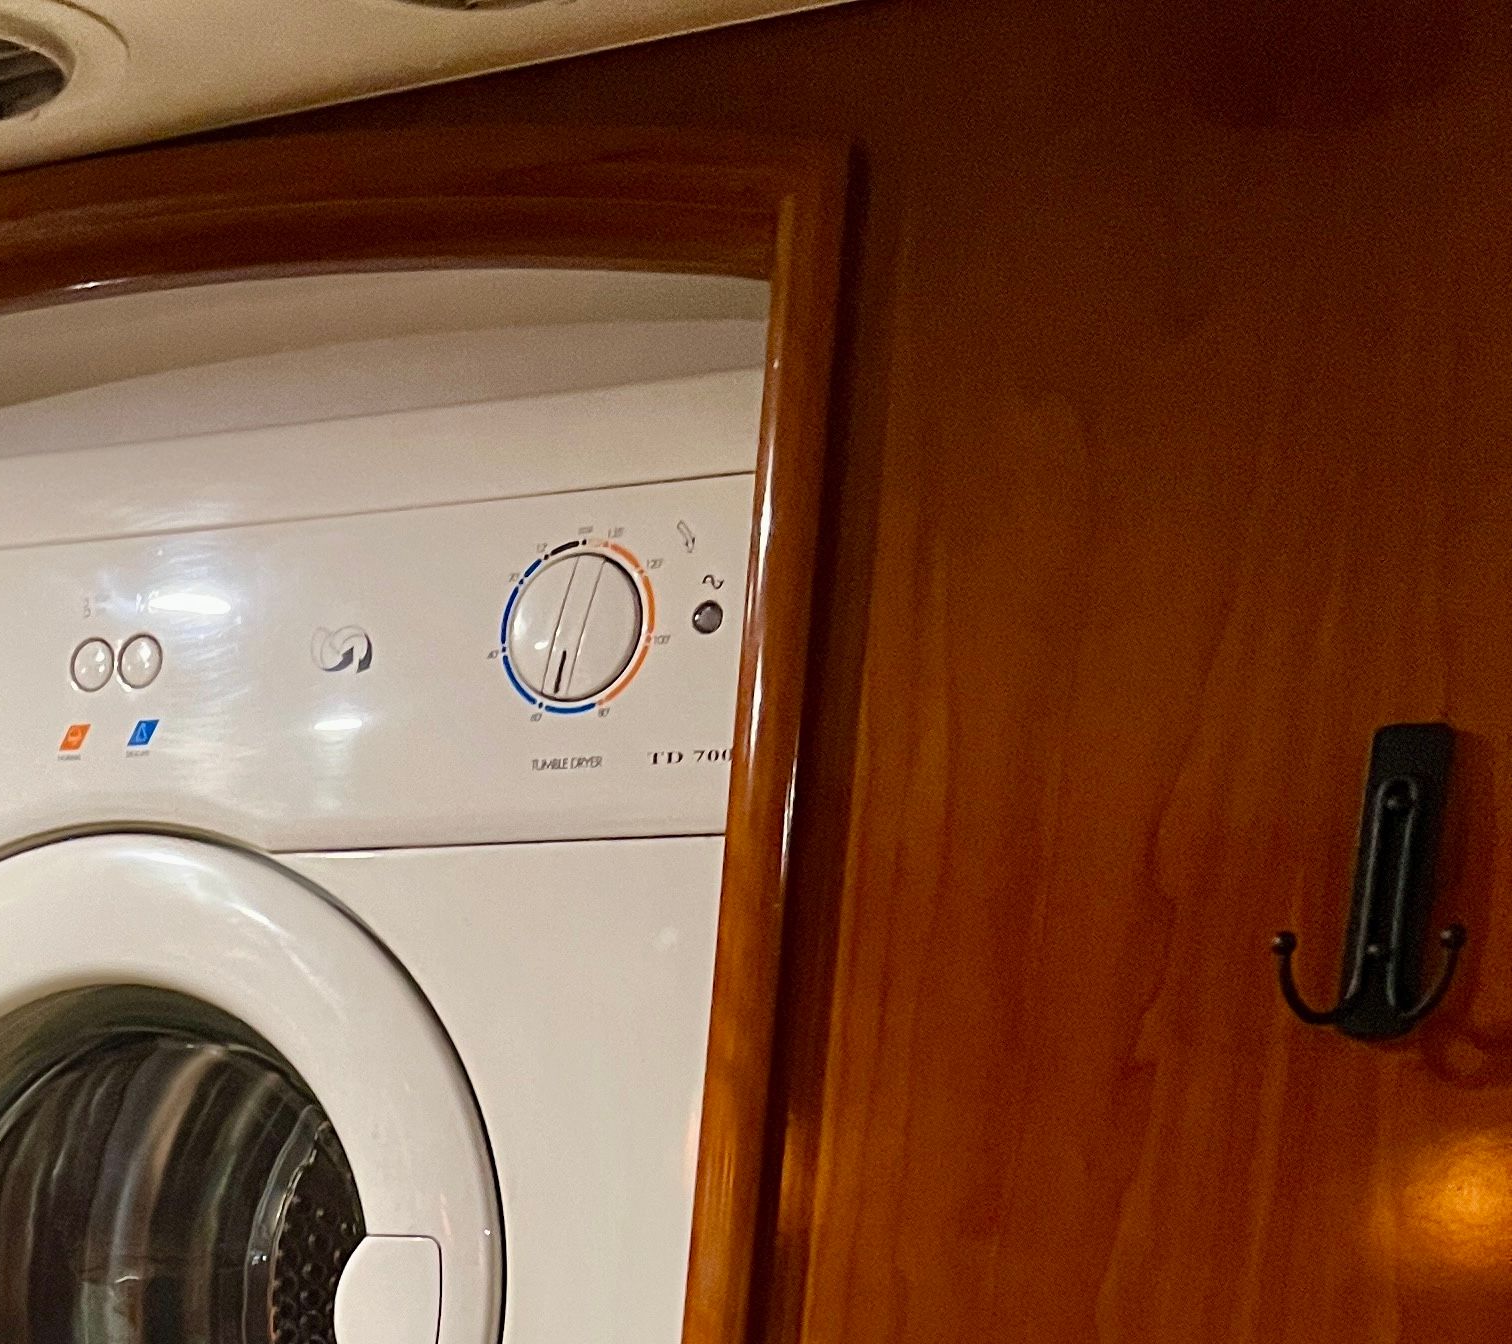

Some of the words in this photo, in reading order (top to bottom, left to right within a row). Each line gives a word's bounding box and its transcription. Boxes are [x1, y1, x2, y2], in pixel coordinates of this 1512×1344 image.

[532, 758, 568, 771] TUMBLE
[569, 756, 603, 769] DRYER
[647, 751, 684, 765] TD
